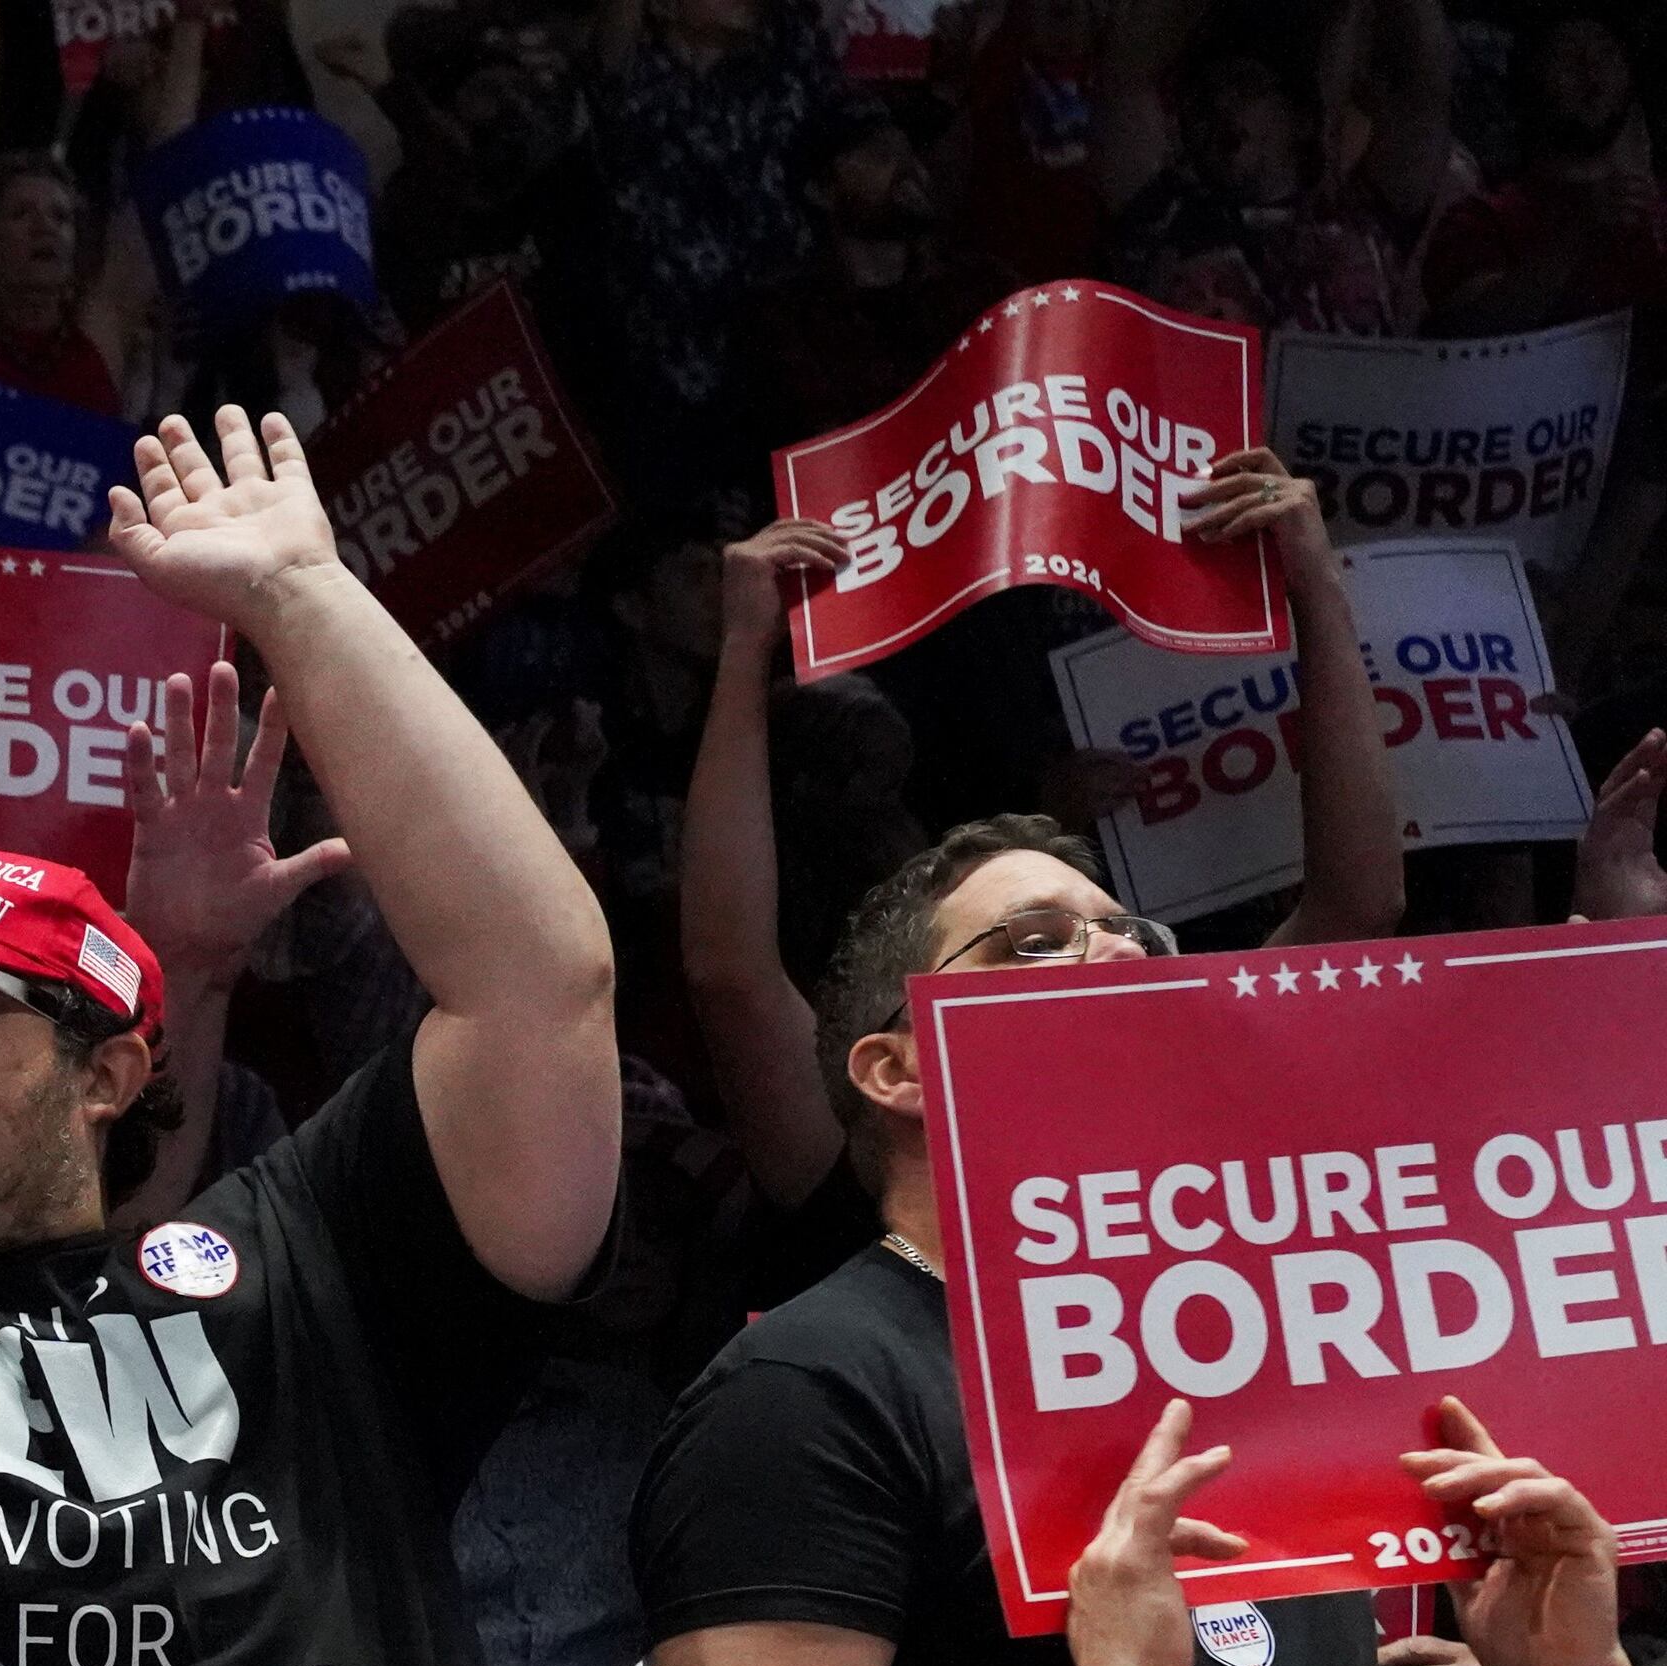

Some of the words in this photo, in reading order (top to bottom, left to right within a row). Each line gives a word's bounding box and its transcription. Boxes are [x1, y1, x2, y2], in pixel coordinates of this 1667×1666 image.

[428, 367, 528, 456] OUR
[1295, 422, 1512, 467] SECURE
[1526, 405, 1598, 460] OUR
[830, 374, 1088, 535] SECURE
[1106, 387, 1216, 480] OUR
[1024, 553, 1102, 592] 2024
[1396, 633, 1518, 674] OUR
[52, 668, 167, 732] OU
[1009, 1142, 1448, 1266] SECURE
[1199, 1613, 1257, 1636] TRUMP
[1211, 1629, 1260, 1647] VANCE
